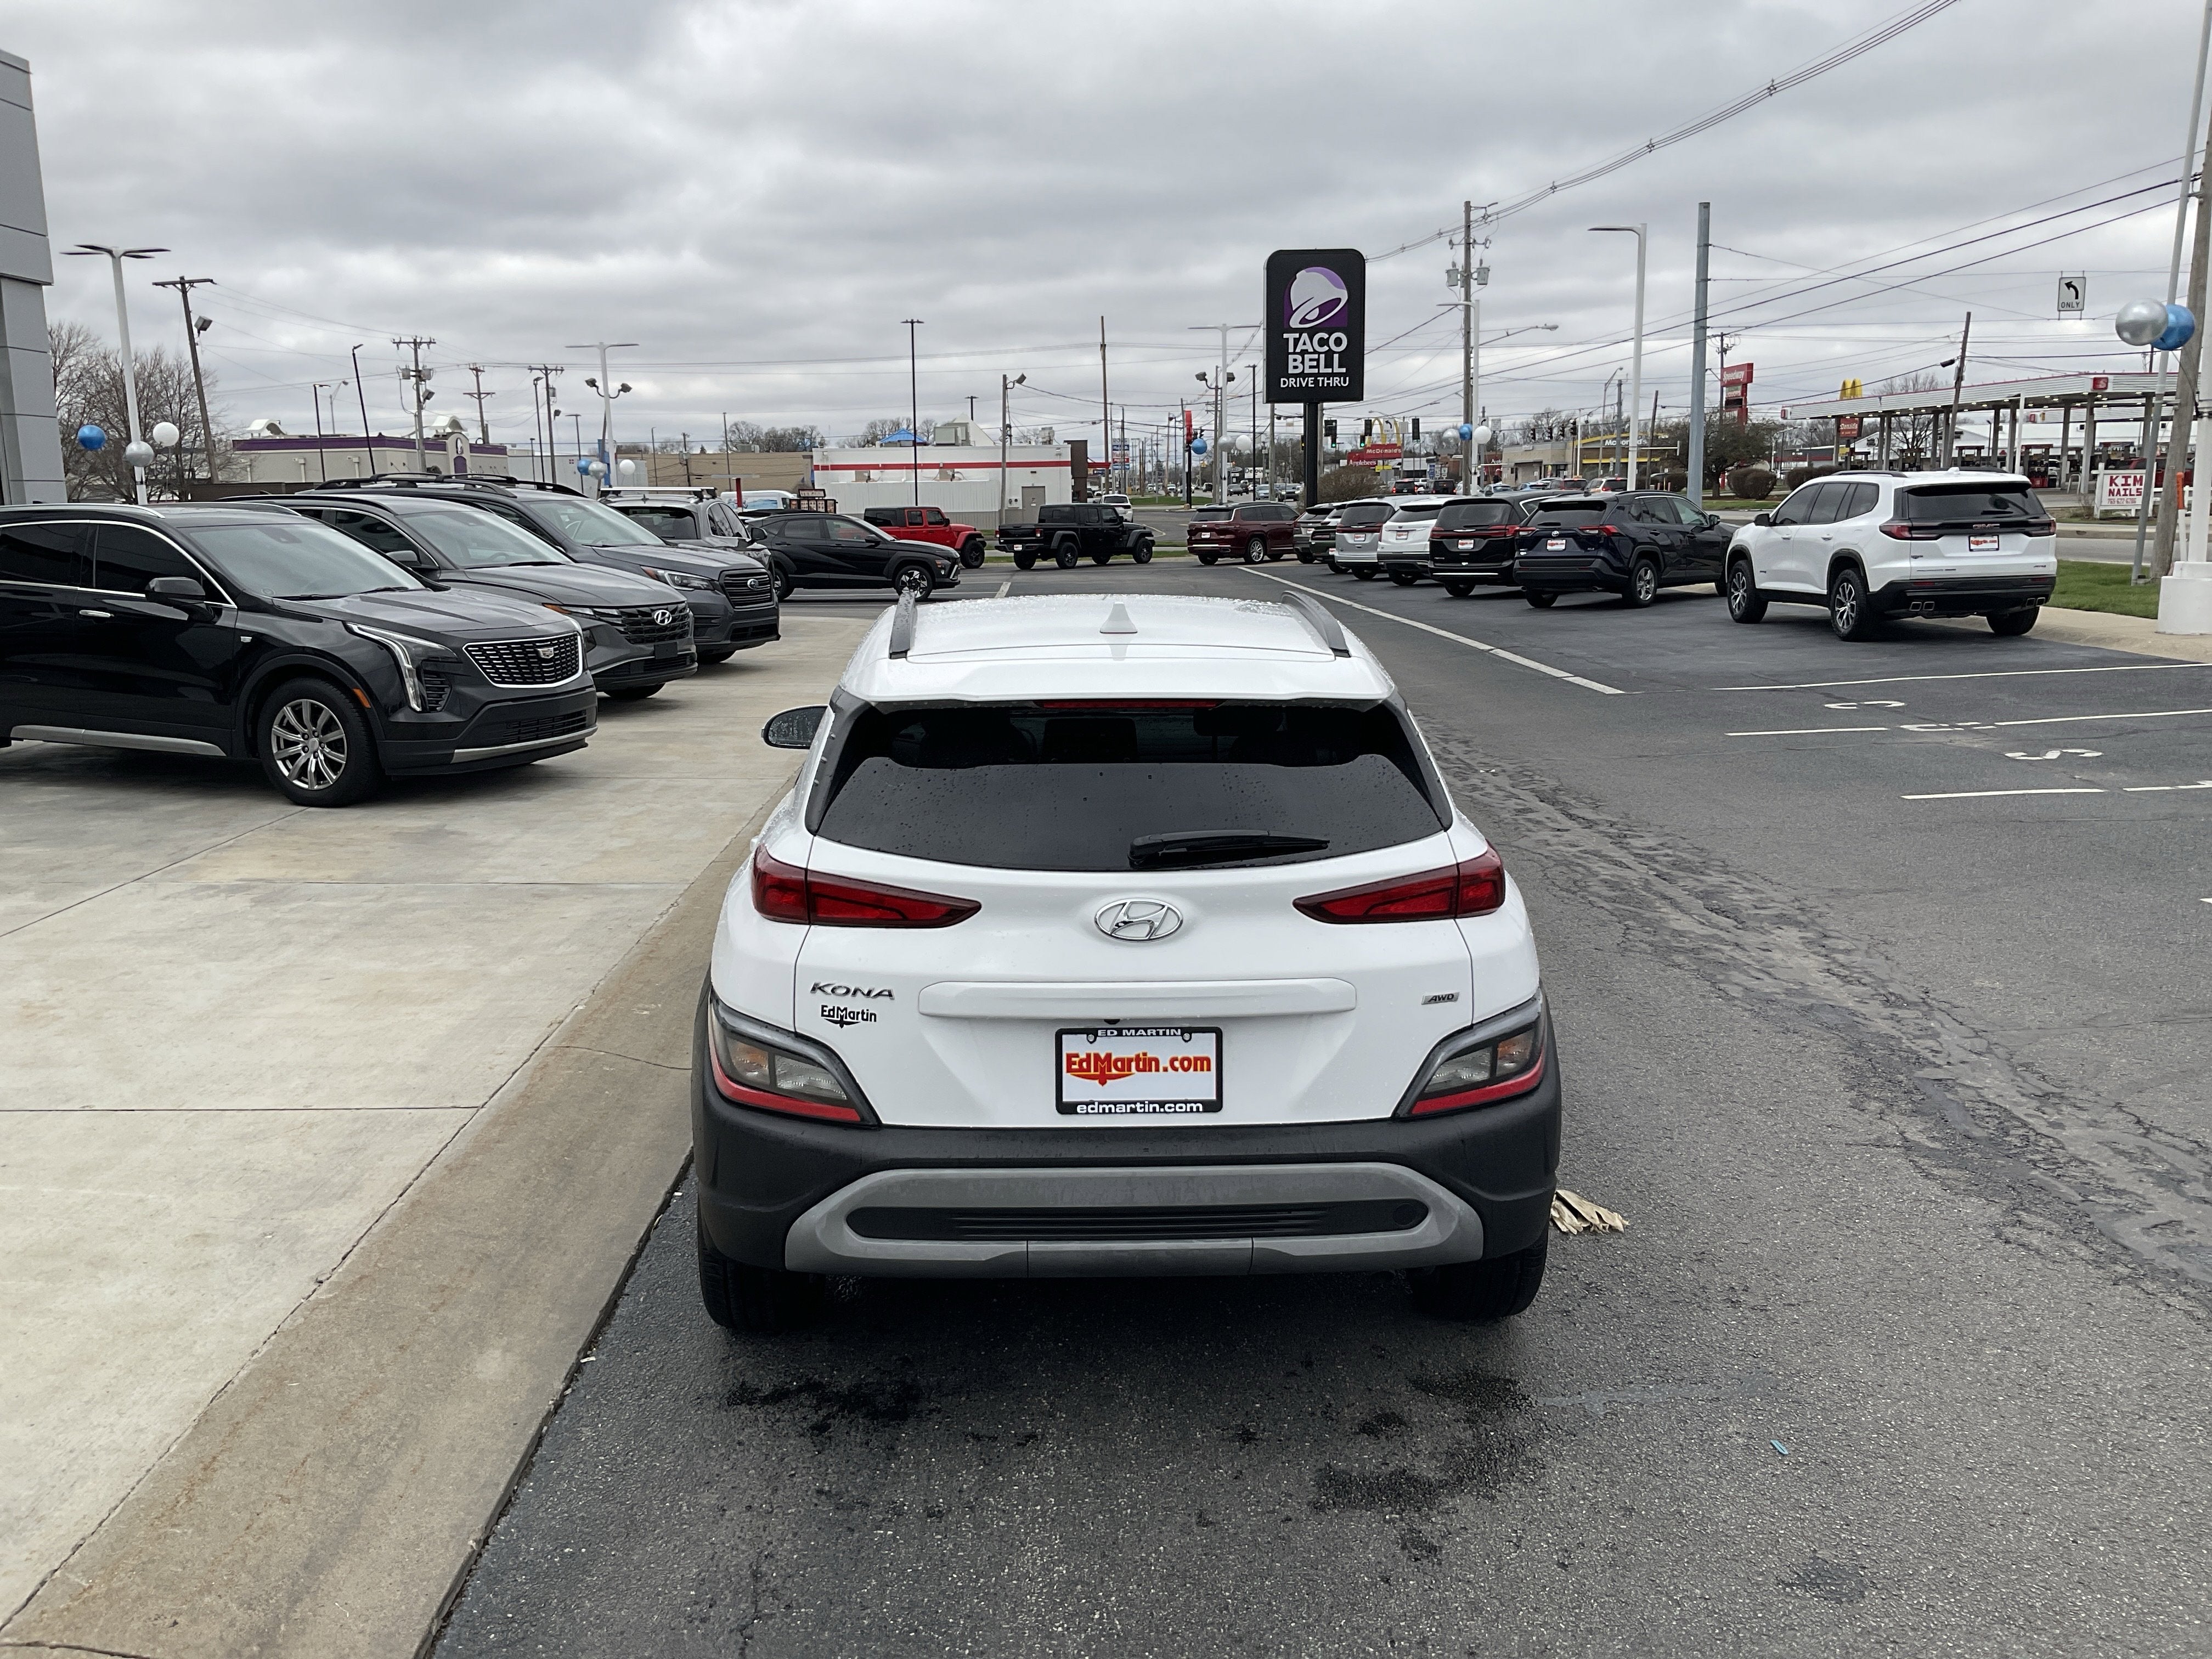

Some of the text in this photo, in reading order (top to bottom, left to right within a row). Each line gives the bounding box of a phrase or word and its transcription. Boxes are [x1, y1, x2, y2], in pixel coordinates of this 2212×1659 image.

[1283, 332, 1347, 352] TACO
[1288, 353, 1346, 374] BELL
[1280, 377, 1349, 387] DRIVE THRU
[1723, 370, 1745, 383] Speedway
[2109, 475, 2143, 487] KIM
[2108, 488, 2142, 496] NAILS
[810, 981, 895, 1000] KONA
[1427, 994, 1454, 1002] AWD
[821, 1005, 877, 1024] EdMartin
[1065, 1051, 1212, 1075] EdMartin.com
[1076, 1101, 1203, 1114] edmartin.com
